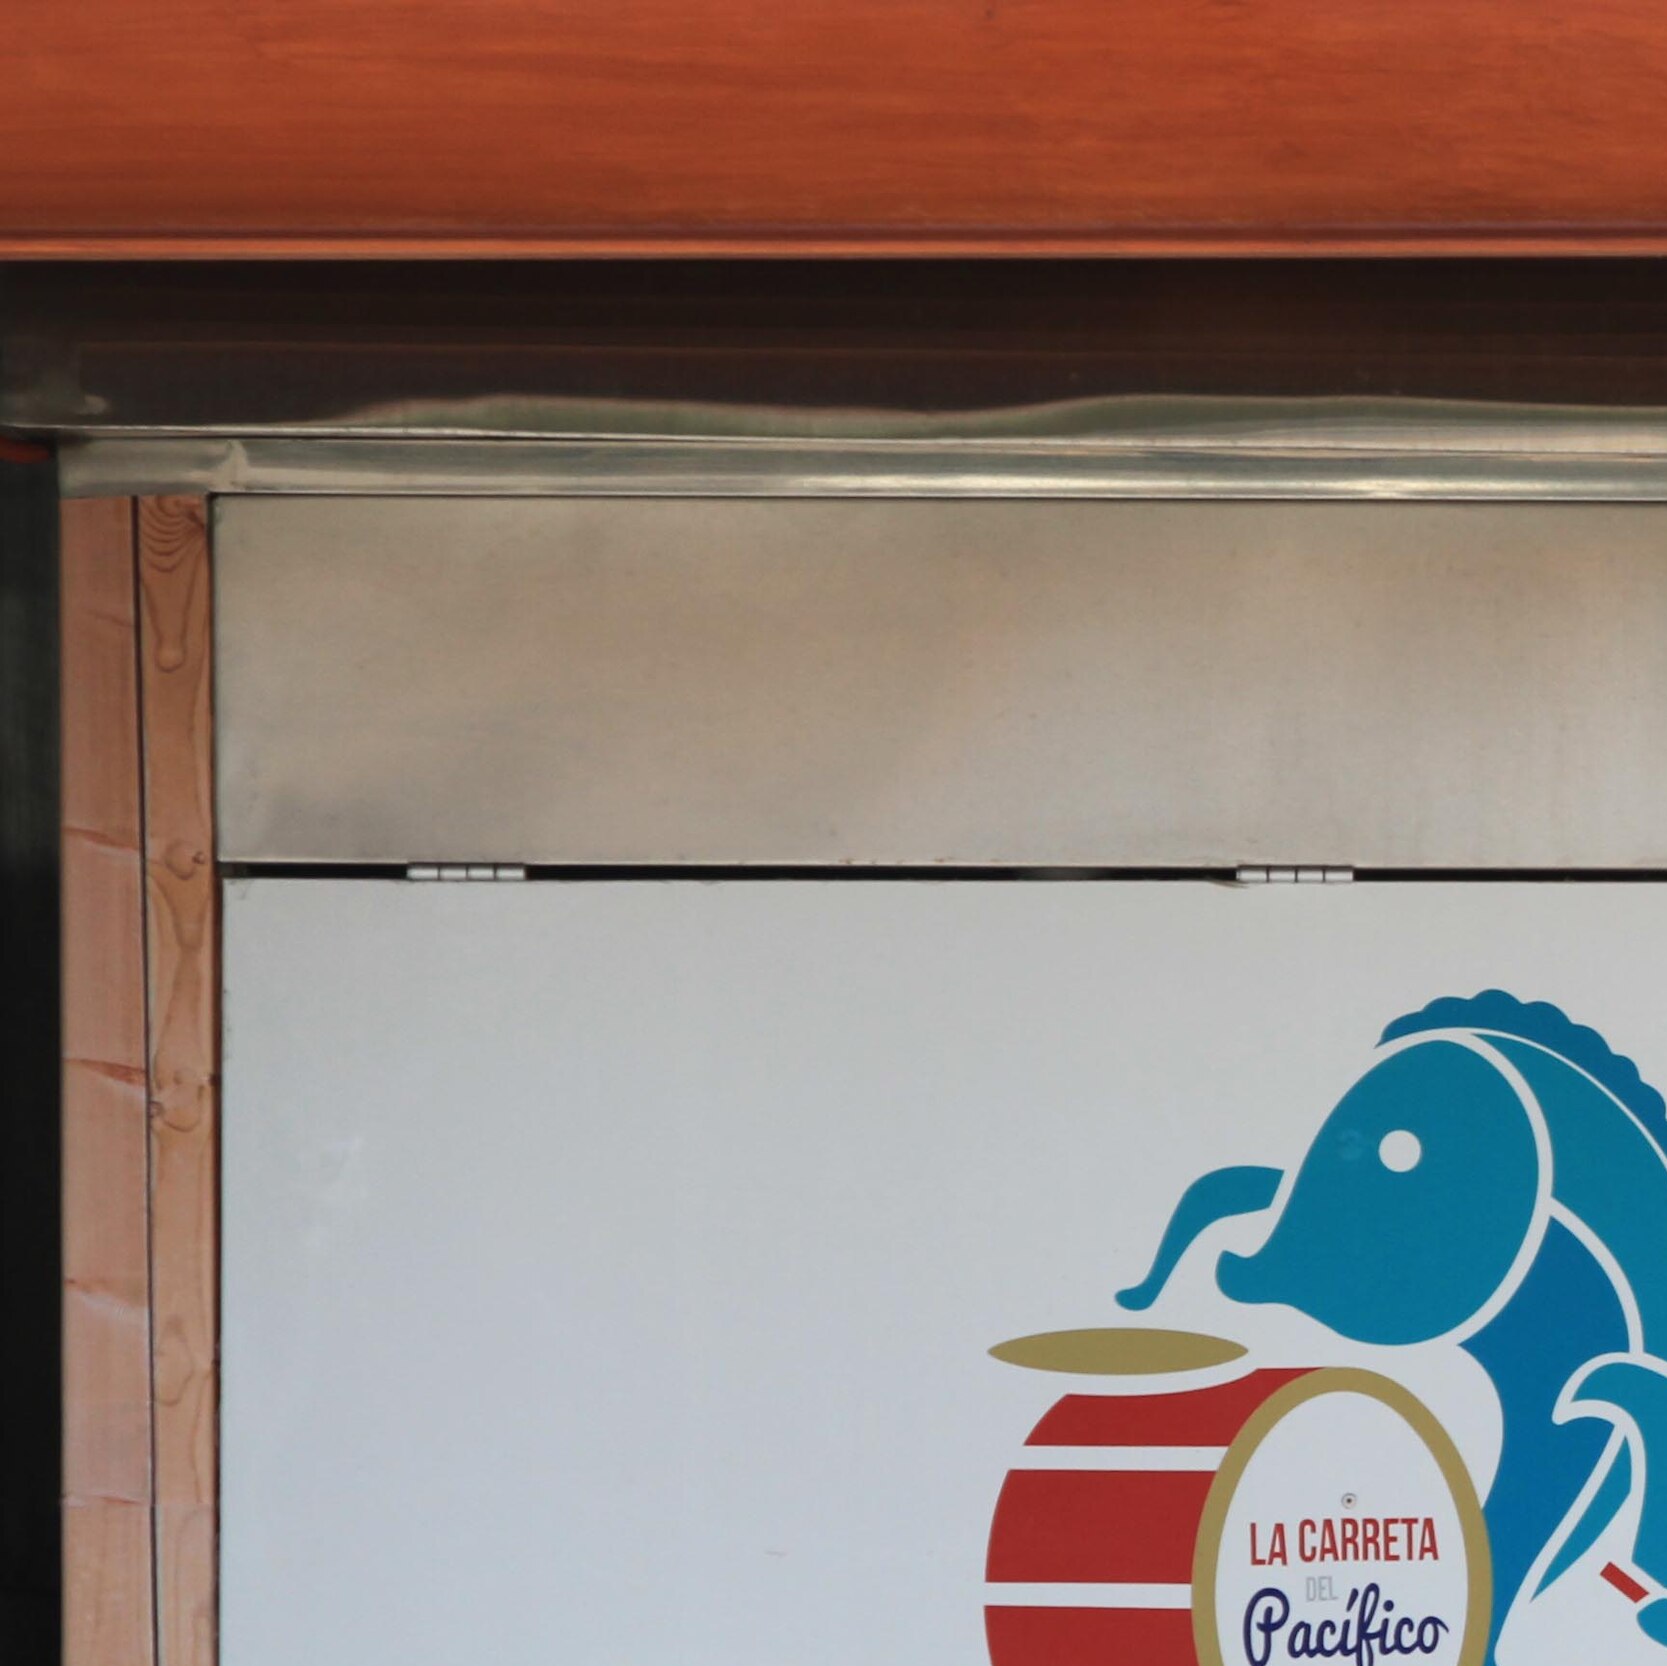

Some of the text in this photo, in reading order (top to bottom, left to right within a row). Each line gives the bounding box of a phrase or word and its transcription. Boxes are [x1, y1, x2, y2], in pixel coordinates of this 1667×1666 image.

[1250, 1517, 1439, 1566] LA CARRETA
[1306, 1575, 1339, 1603] DEL
